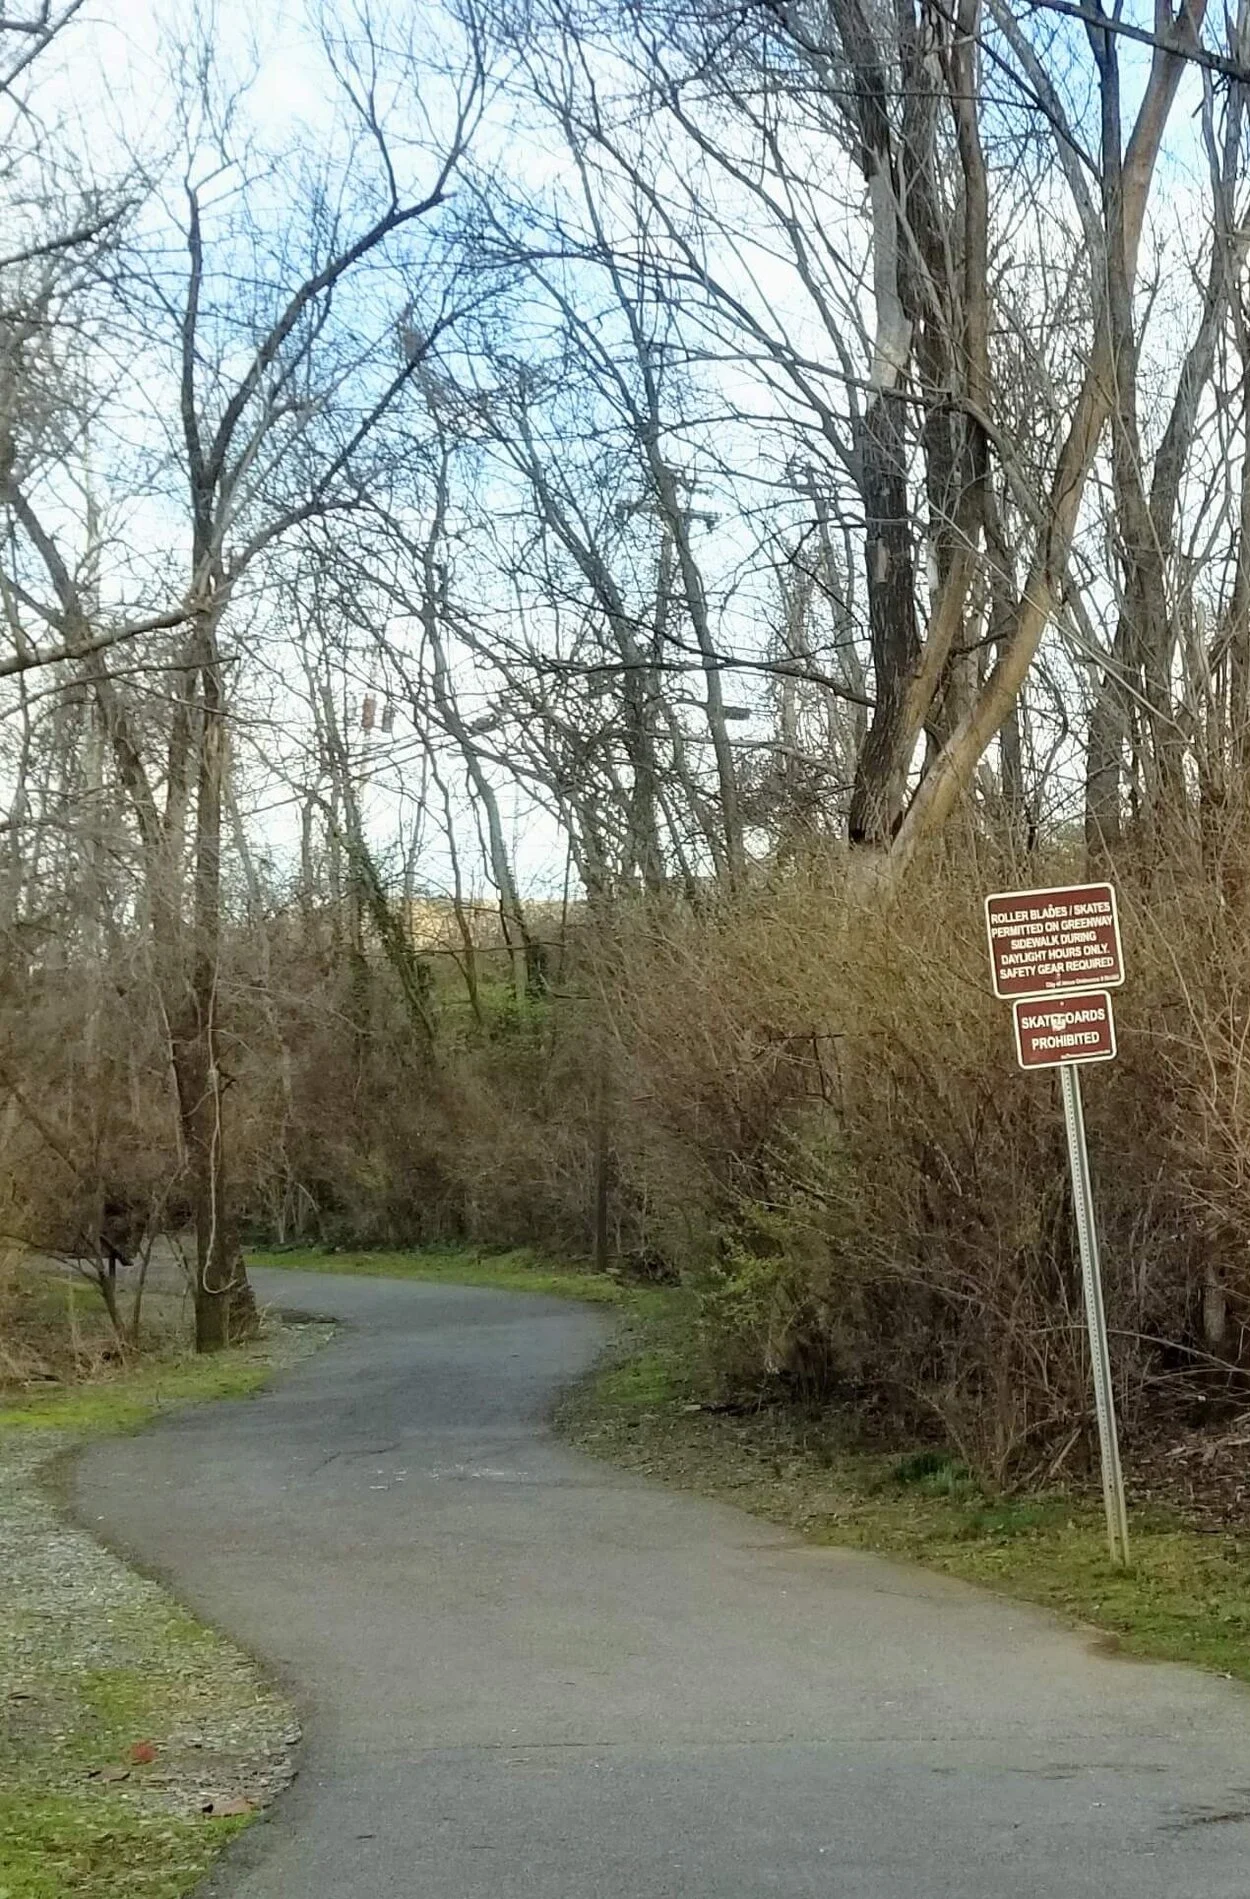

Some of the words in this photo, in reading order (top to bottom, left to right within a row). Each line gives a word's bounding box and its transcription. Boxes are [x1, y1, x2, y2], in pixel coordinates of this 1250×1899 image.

[991, 911, 1028, 924] ROLLER
[1030, 906, 1067, 920] BLADES
[1074, 902, 1111, 915] SKATES
[992, 923, 1044, 938] PERMITTED
[1045, 921, 1059, 931] ON
[1061, 915, 1113, 930] GREENWAY
[1011, 937, 1059, 950] SIDEWALK
[1061, 931, 1097, 944] DURING
[1001, 951, 1047, 965] DAYLIGHT
[1049, 947, 1082, 959] HOURS
[1084, 943, 1110, 955] ONLY.
[1000, 965, 1036, 979] SAFETY
[1038, 963, 1064, 974] GEAR
[1066, 957, 1114, 971] REQUIRED
[1021, 1008, 1106, 1029] SKATOARDS
[1031, 1031, 1100, 1050] PROHIBITED
